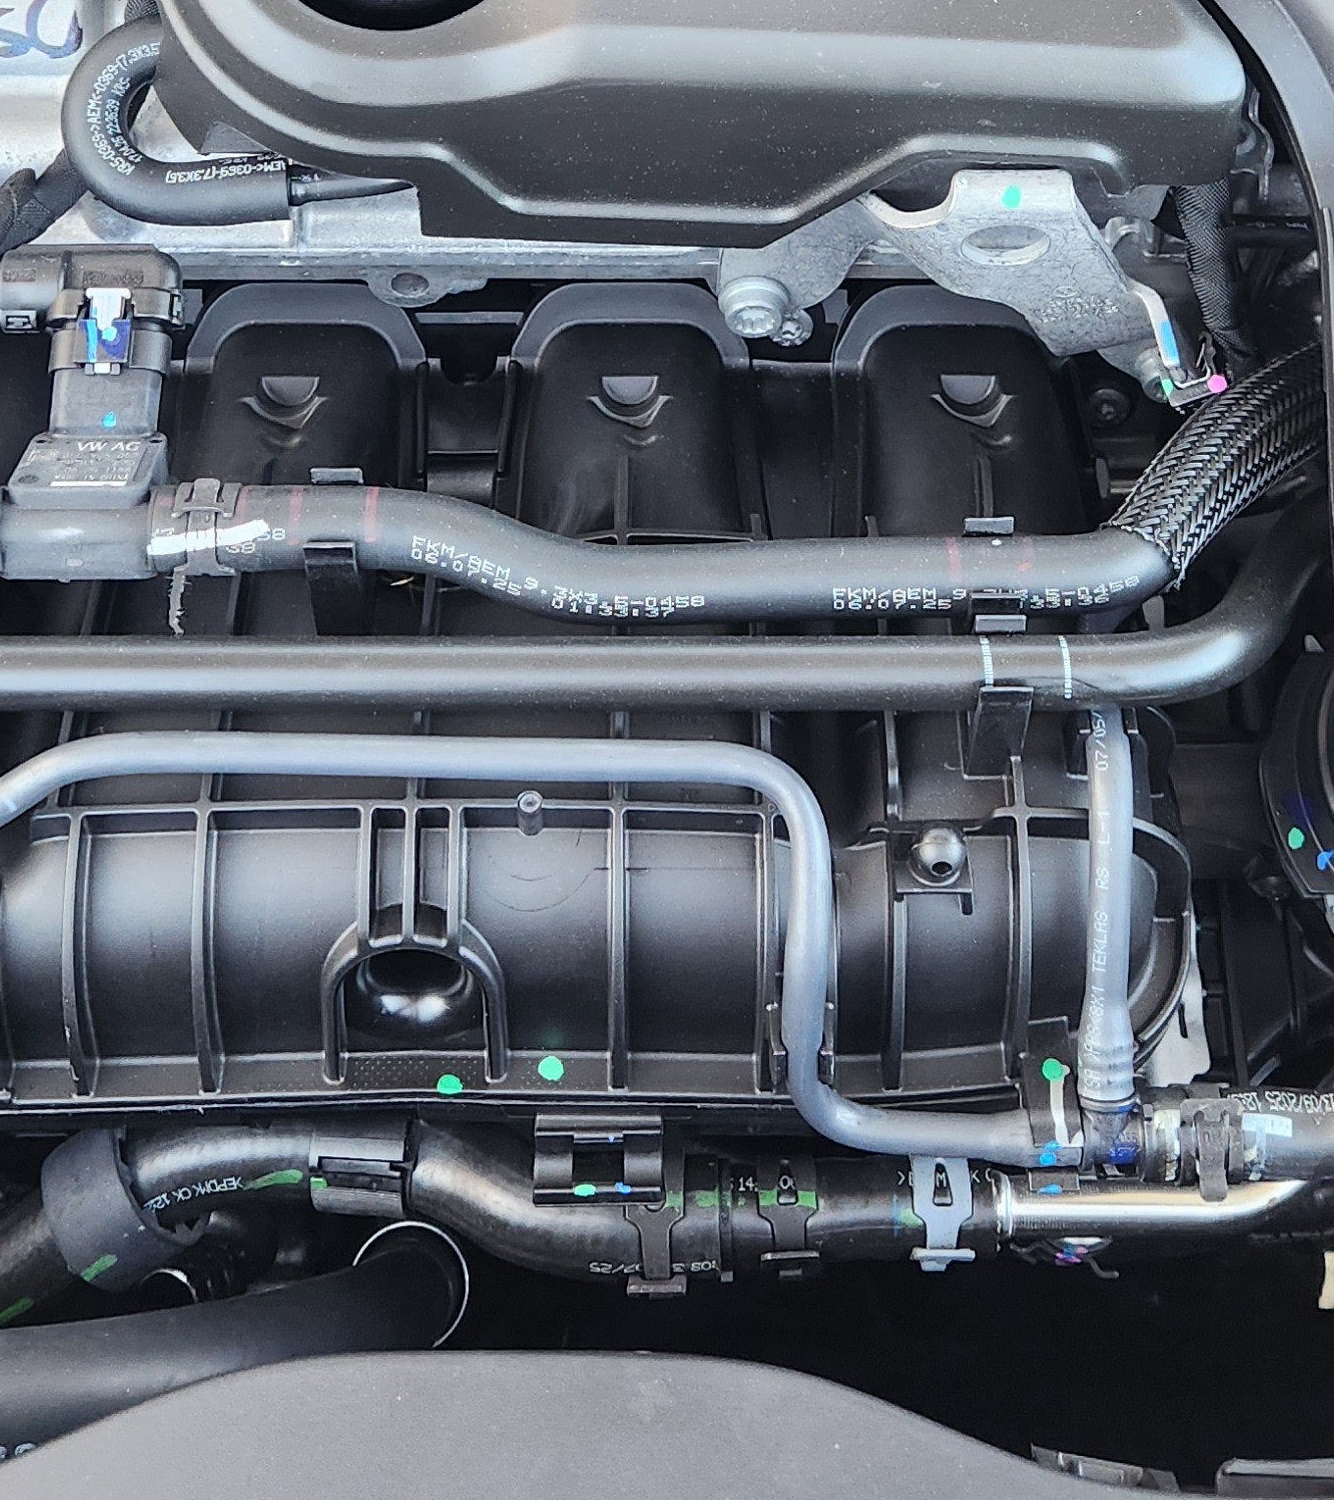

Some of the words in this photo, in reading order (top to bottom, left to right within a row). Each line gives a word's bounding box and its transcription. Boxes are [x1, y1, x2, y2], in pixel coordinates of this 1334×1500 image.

[77, 441, 108, 452] VW
[110, 441, 142, 452] AG
[1091, 911, 1109, 973] TEKLAS
